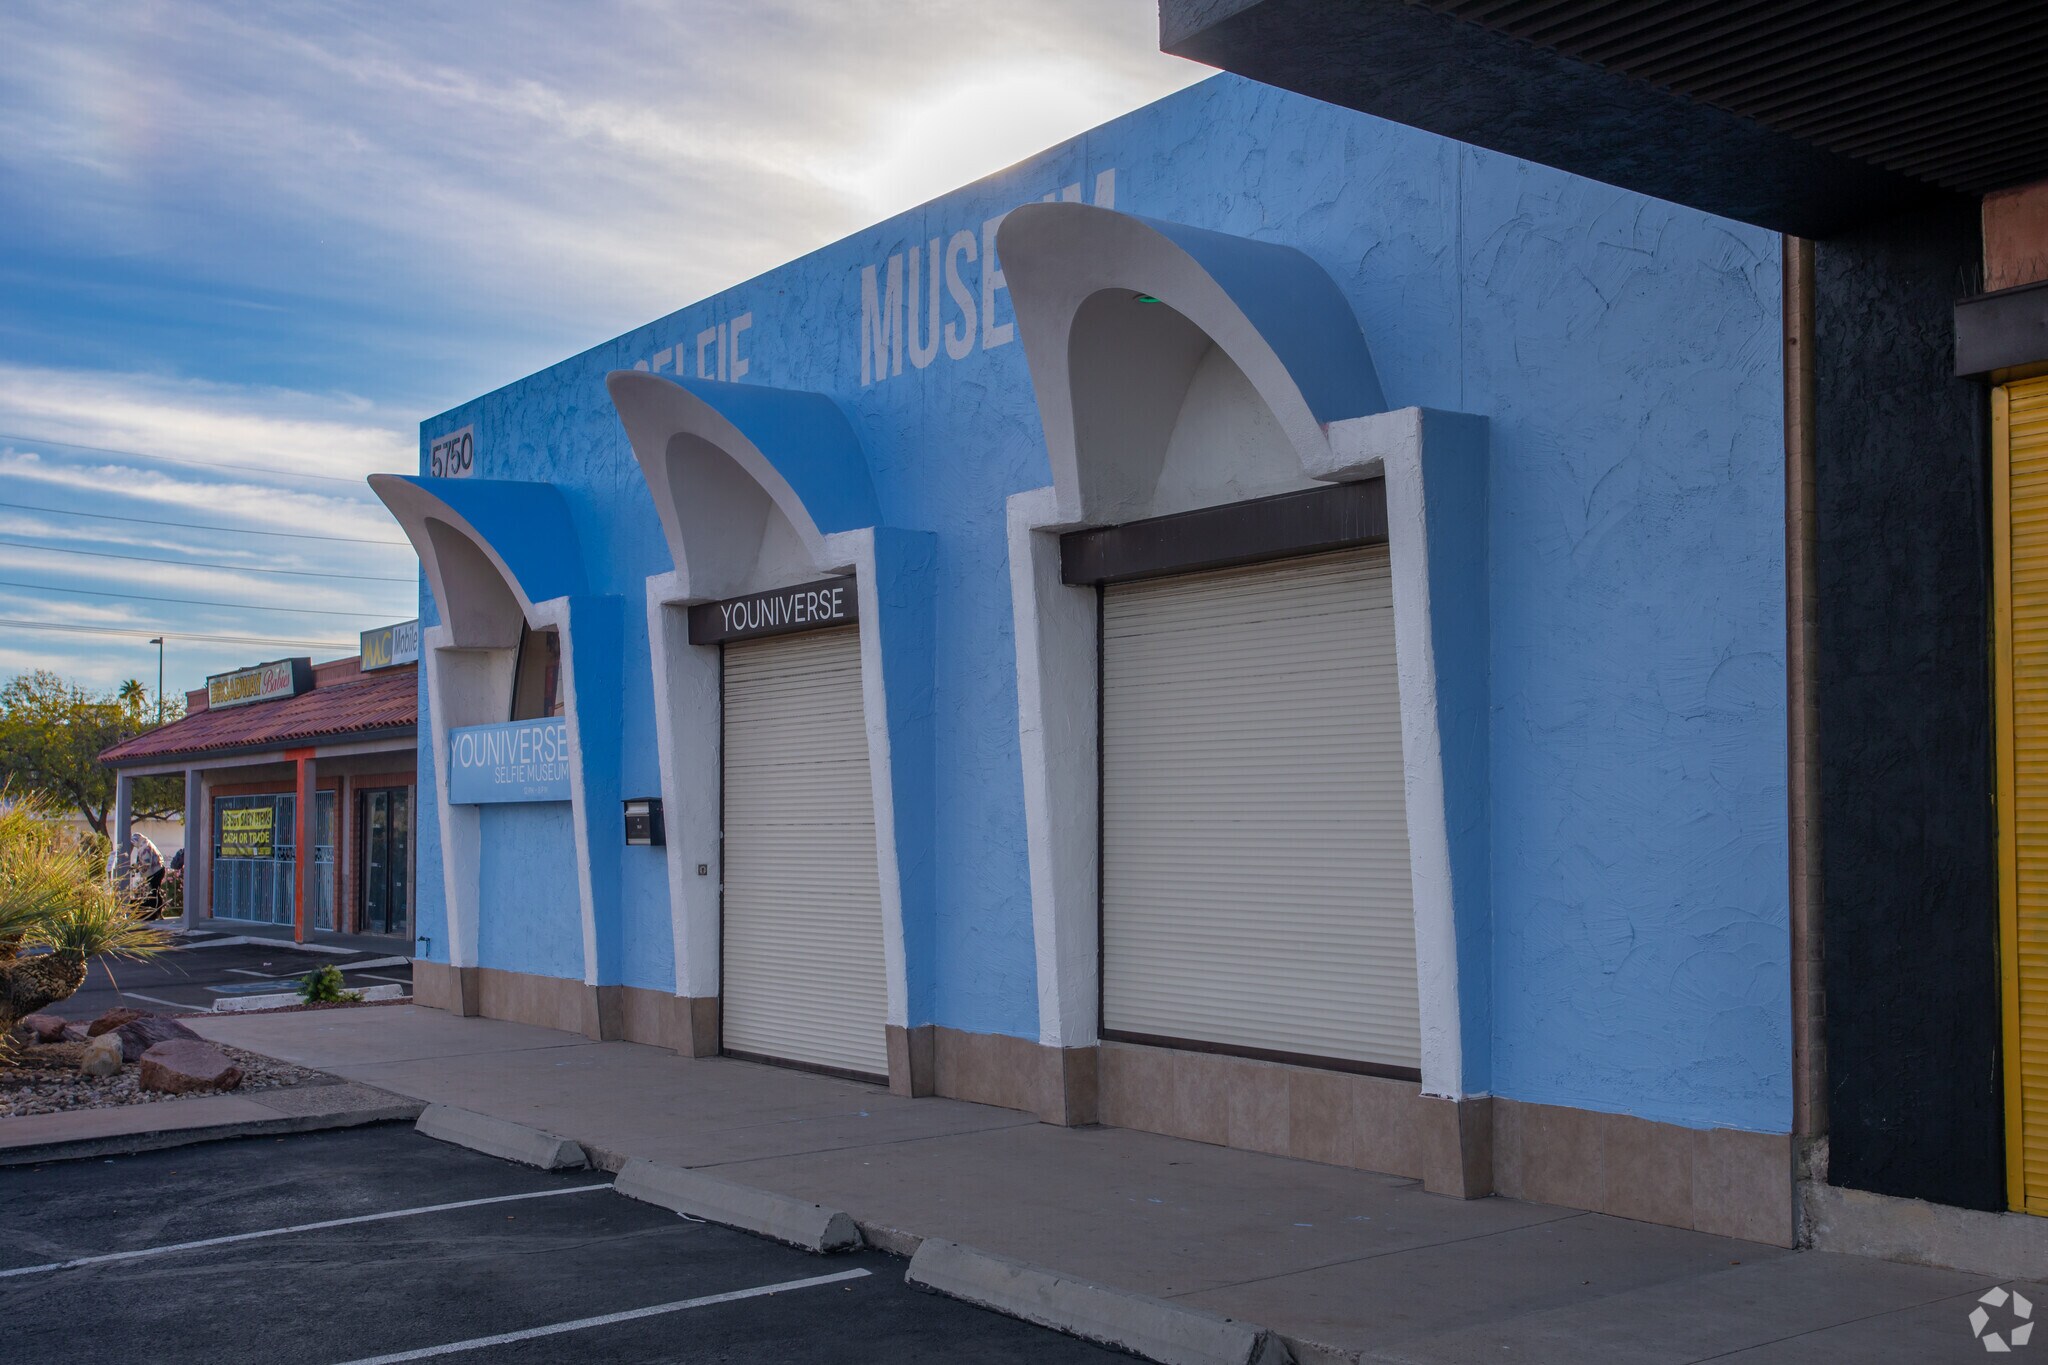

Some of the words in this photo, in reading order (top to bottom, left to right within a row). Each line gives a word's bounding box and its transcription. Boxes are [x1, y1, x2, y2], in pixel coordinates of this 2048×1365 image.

[861, 168, 1116, 387] MUSE
[432, 432, 473, 478] 5750
[720, 587, 844, 632] YOUNIVERSE
[363, 631, 391, 669] MAC
[394, 624, 418, 655] Mobile
[211, 672, 262, 704] BROADWAY
[262, 668, 290, 695] Babies
[451, 725, 569, 768] YOUNIVERSE
[495, 765, 526, 784] SELFIE
[527, 763, 569, 782] MUSEUM
[223, 832, 238, 844] CASH
[239, 832, 248, 844] OR
[248, 831, 270, 844] TRADE
